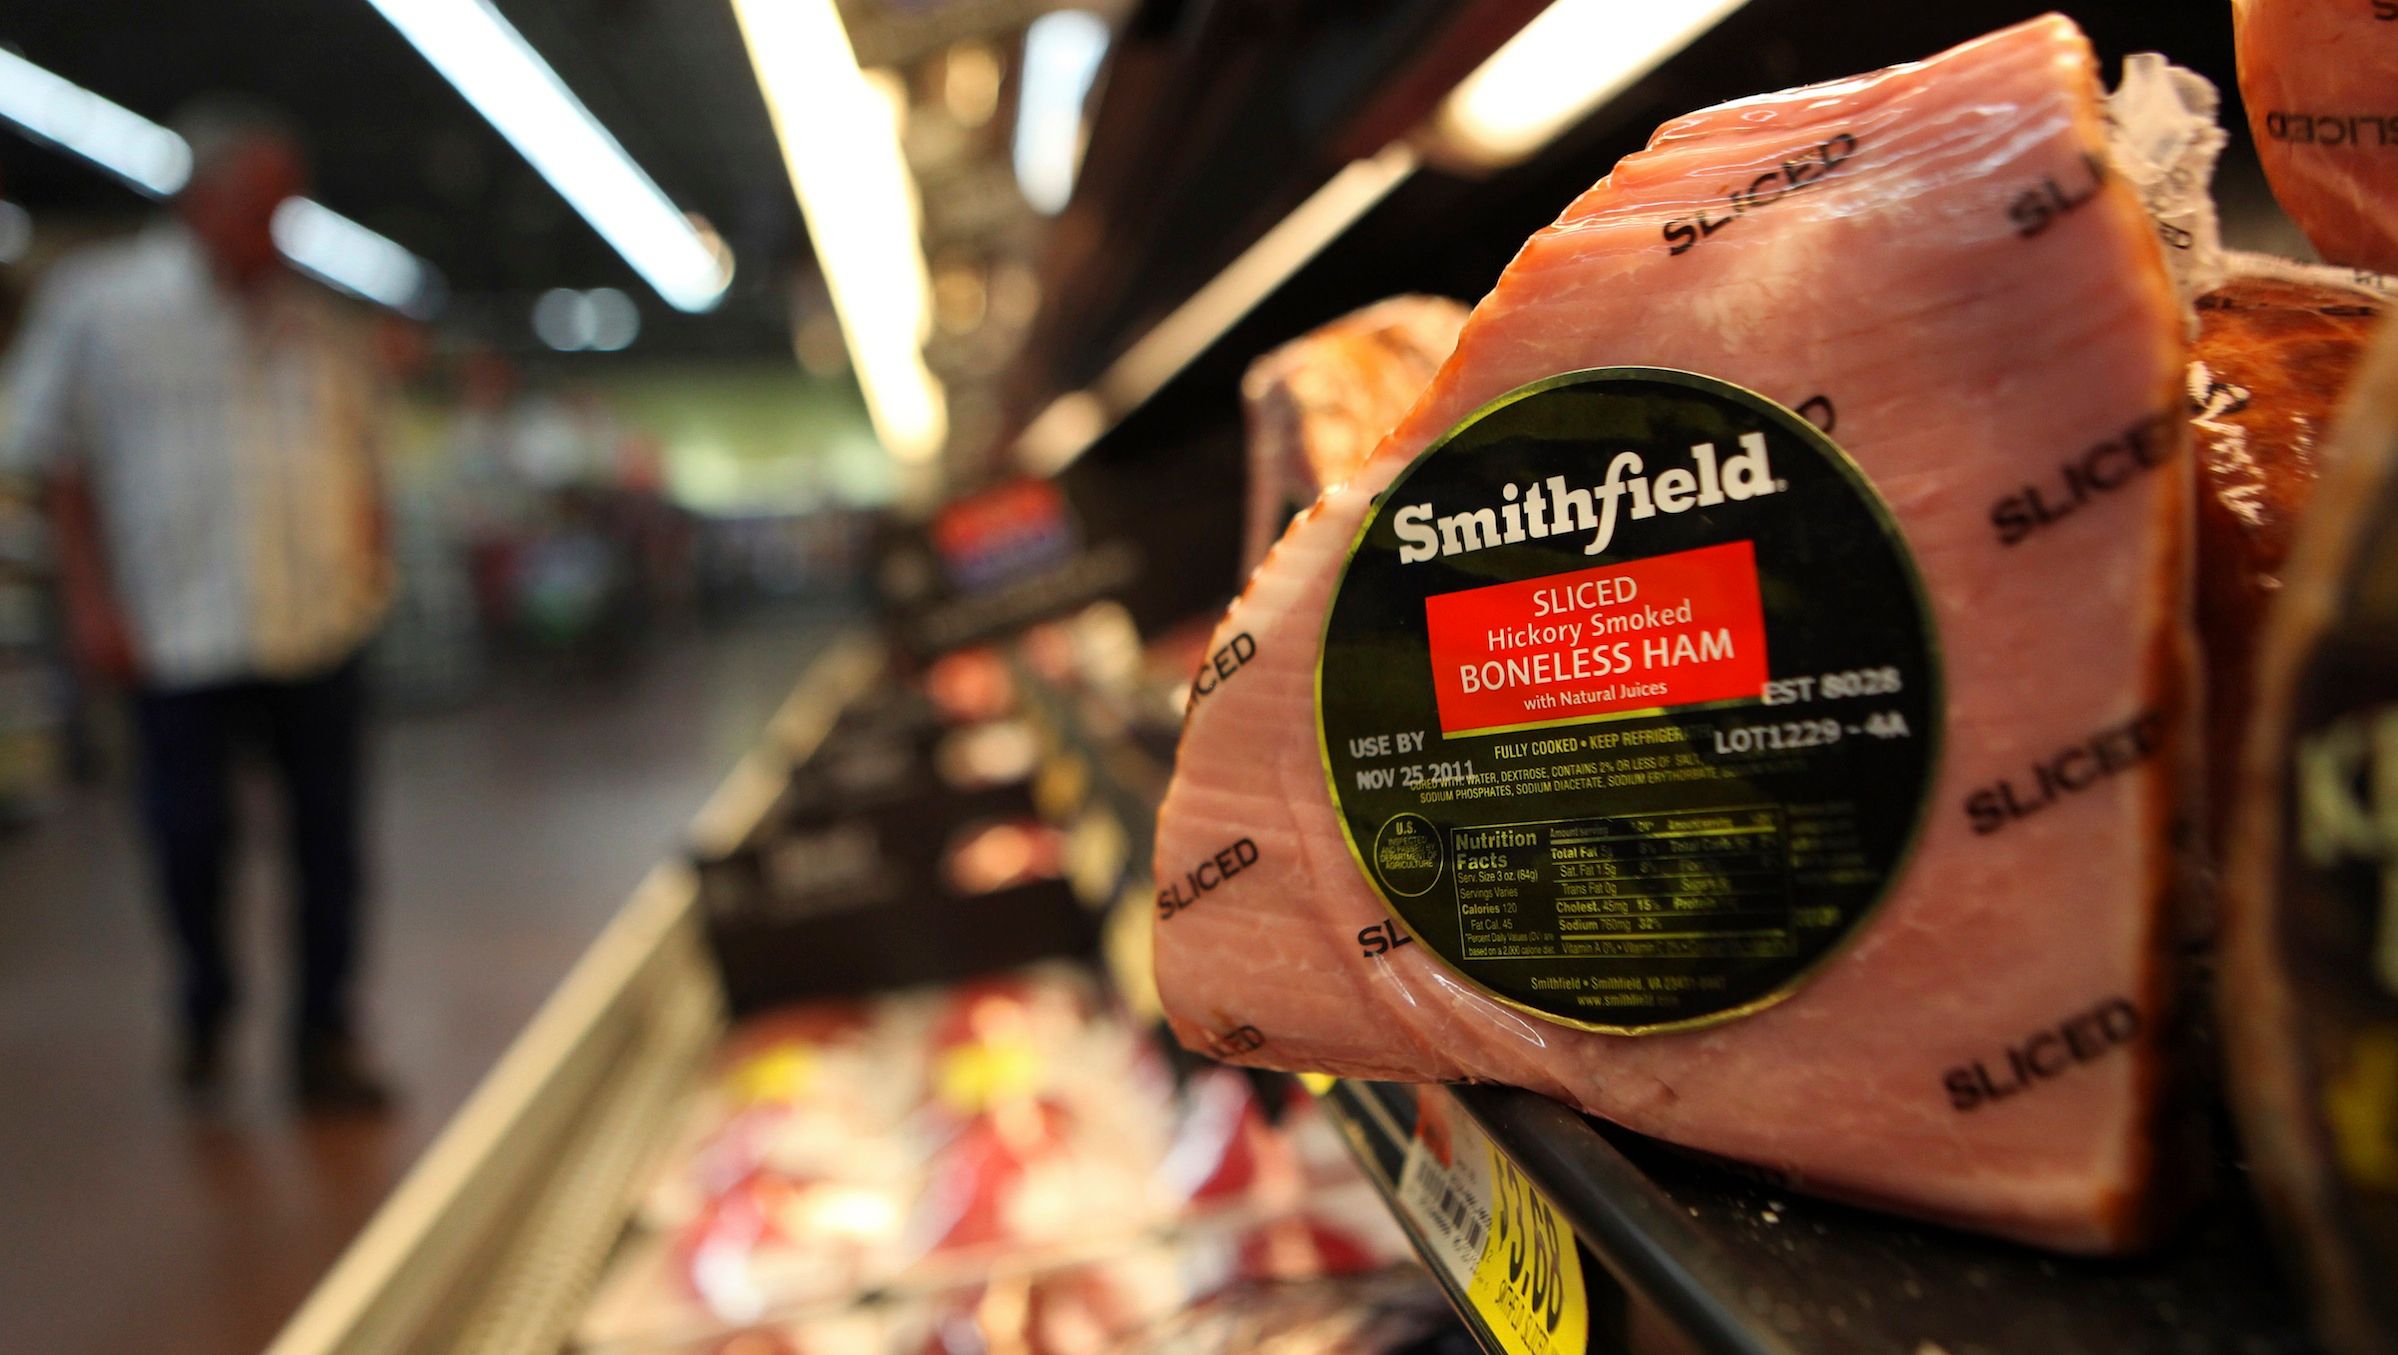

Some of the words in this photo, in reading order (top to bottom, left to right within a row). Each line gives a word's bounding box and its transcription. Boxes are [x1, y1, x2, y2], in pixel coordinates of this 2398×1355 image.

[1662, 131, 1858, 257] SLICED
[1393, 431, 1776, 565] Smithfield
[1533, 576, 1638, 617] SLICED
[1487, 619, 1583, 652] Hickory
[1591, 599, 1692, 637] Smoked
[1460, 643, 1633, 694] BONELESS
[1643, 628, 1735, 670] HAM
[1524, 693, 1557, 711] with
[1560, 684, 1617, 708] Natural
[1619, 679, 1668, 701] Juices
[1761, 677, 1816, 706] EST
[1350, 738, 1392, 758] USE
[1396, 731, 1425, 752] BY
[1494, 742, 1528, 760] FULLY
[1532, 737, 1578, 756] COOKED
[1590, 733, 1620, 749] KEEP
[1714, 718, 1842, 754] LOT1229
[1356, 768, 1395, 790] NOV
[1400, 765, 1424, 787] 25
[1429, 759, 1475, 782] 2011
[1500, 767, 1550, 783] DEXTROSE,
[1551, 762, 1597, 777] CONTAINS
[1599, 760, 1614, 773] 2%
[1616, 758, 1630, 771] OR
[1632, 755, 1657, 770] LESS
[1420, 790, 1454, 804] SODIUM
[1455, 786, 1515, 801] PHOSPHATES,
[1516, 782, 1551, 796] SODIUM
[1554, 777, 1606, 792] DIACETATE,
[1608, 773, 1646, 787] SODIUM
[1395, 820, 1417, 836] U.S.
[1455, 830, 1537, 850] Nutrition
[1457, 852, 1508, 870] Facts
[1551, 846, 1577, 860] Total
[1580, 845, 1598, 858] Fat
[1157, 837, 1260, 922] SLICED
[1458, 871, 1477, 885] Serv.
[1479, 870, 1495, 882] Size
[1497, 870, 1503, 881] 3
[1504, 870, 1516, 881] oz.
[1517, 868, 1538, 882] (84g)
[1580, 863, 1595, 877] Fat
[1460, 887, 1492, 901] Servings
[1495, 885, 1518, 898] Varies
[1562, 881, 1587, 896] Trans
[1589, 881, 1603, 895] Fat
[1462, 903, 1500, 915] Calories
[1502, 902, 1517, 913] 120
[1556, 900, 1601, 914] Cholest.
[1471, 918, 1484, 931] Fat
[1485, 919, 1500, 930] Cal.
[1502, 919, 1513, 930] 45
[1559, 919, 1599, 931] Sodium
[1531, 977, 1581, 991] Smithfield
[1943, 997, 2142, 1112] SLICED
